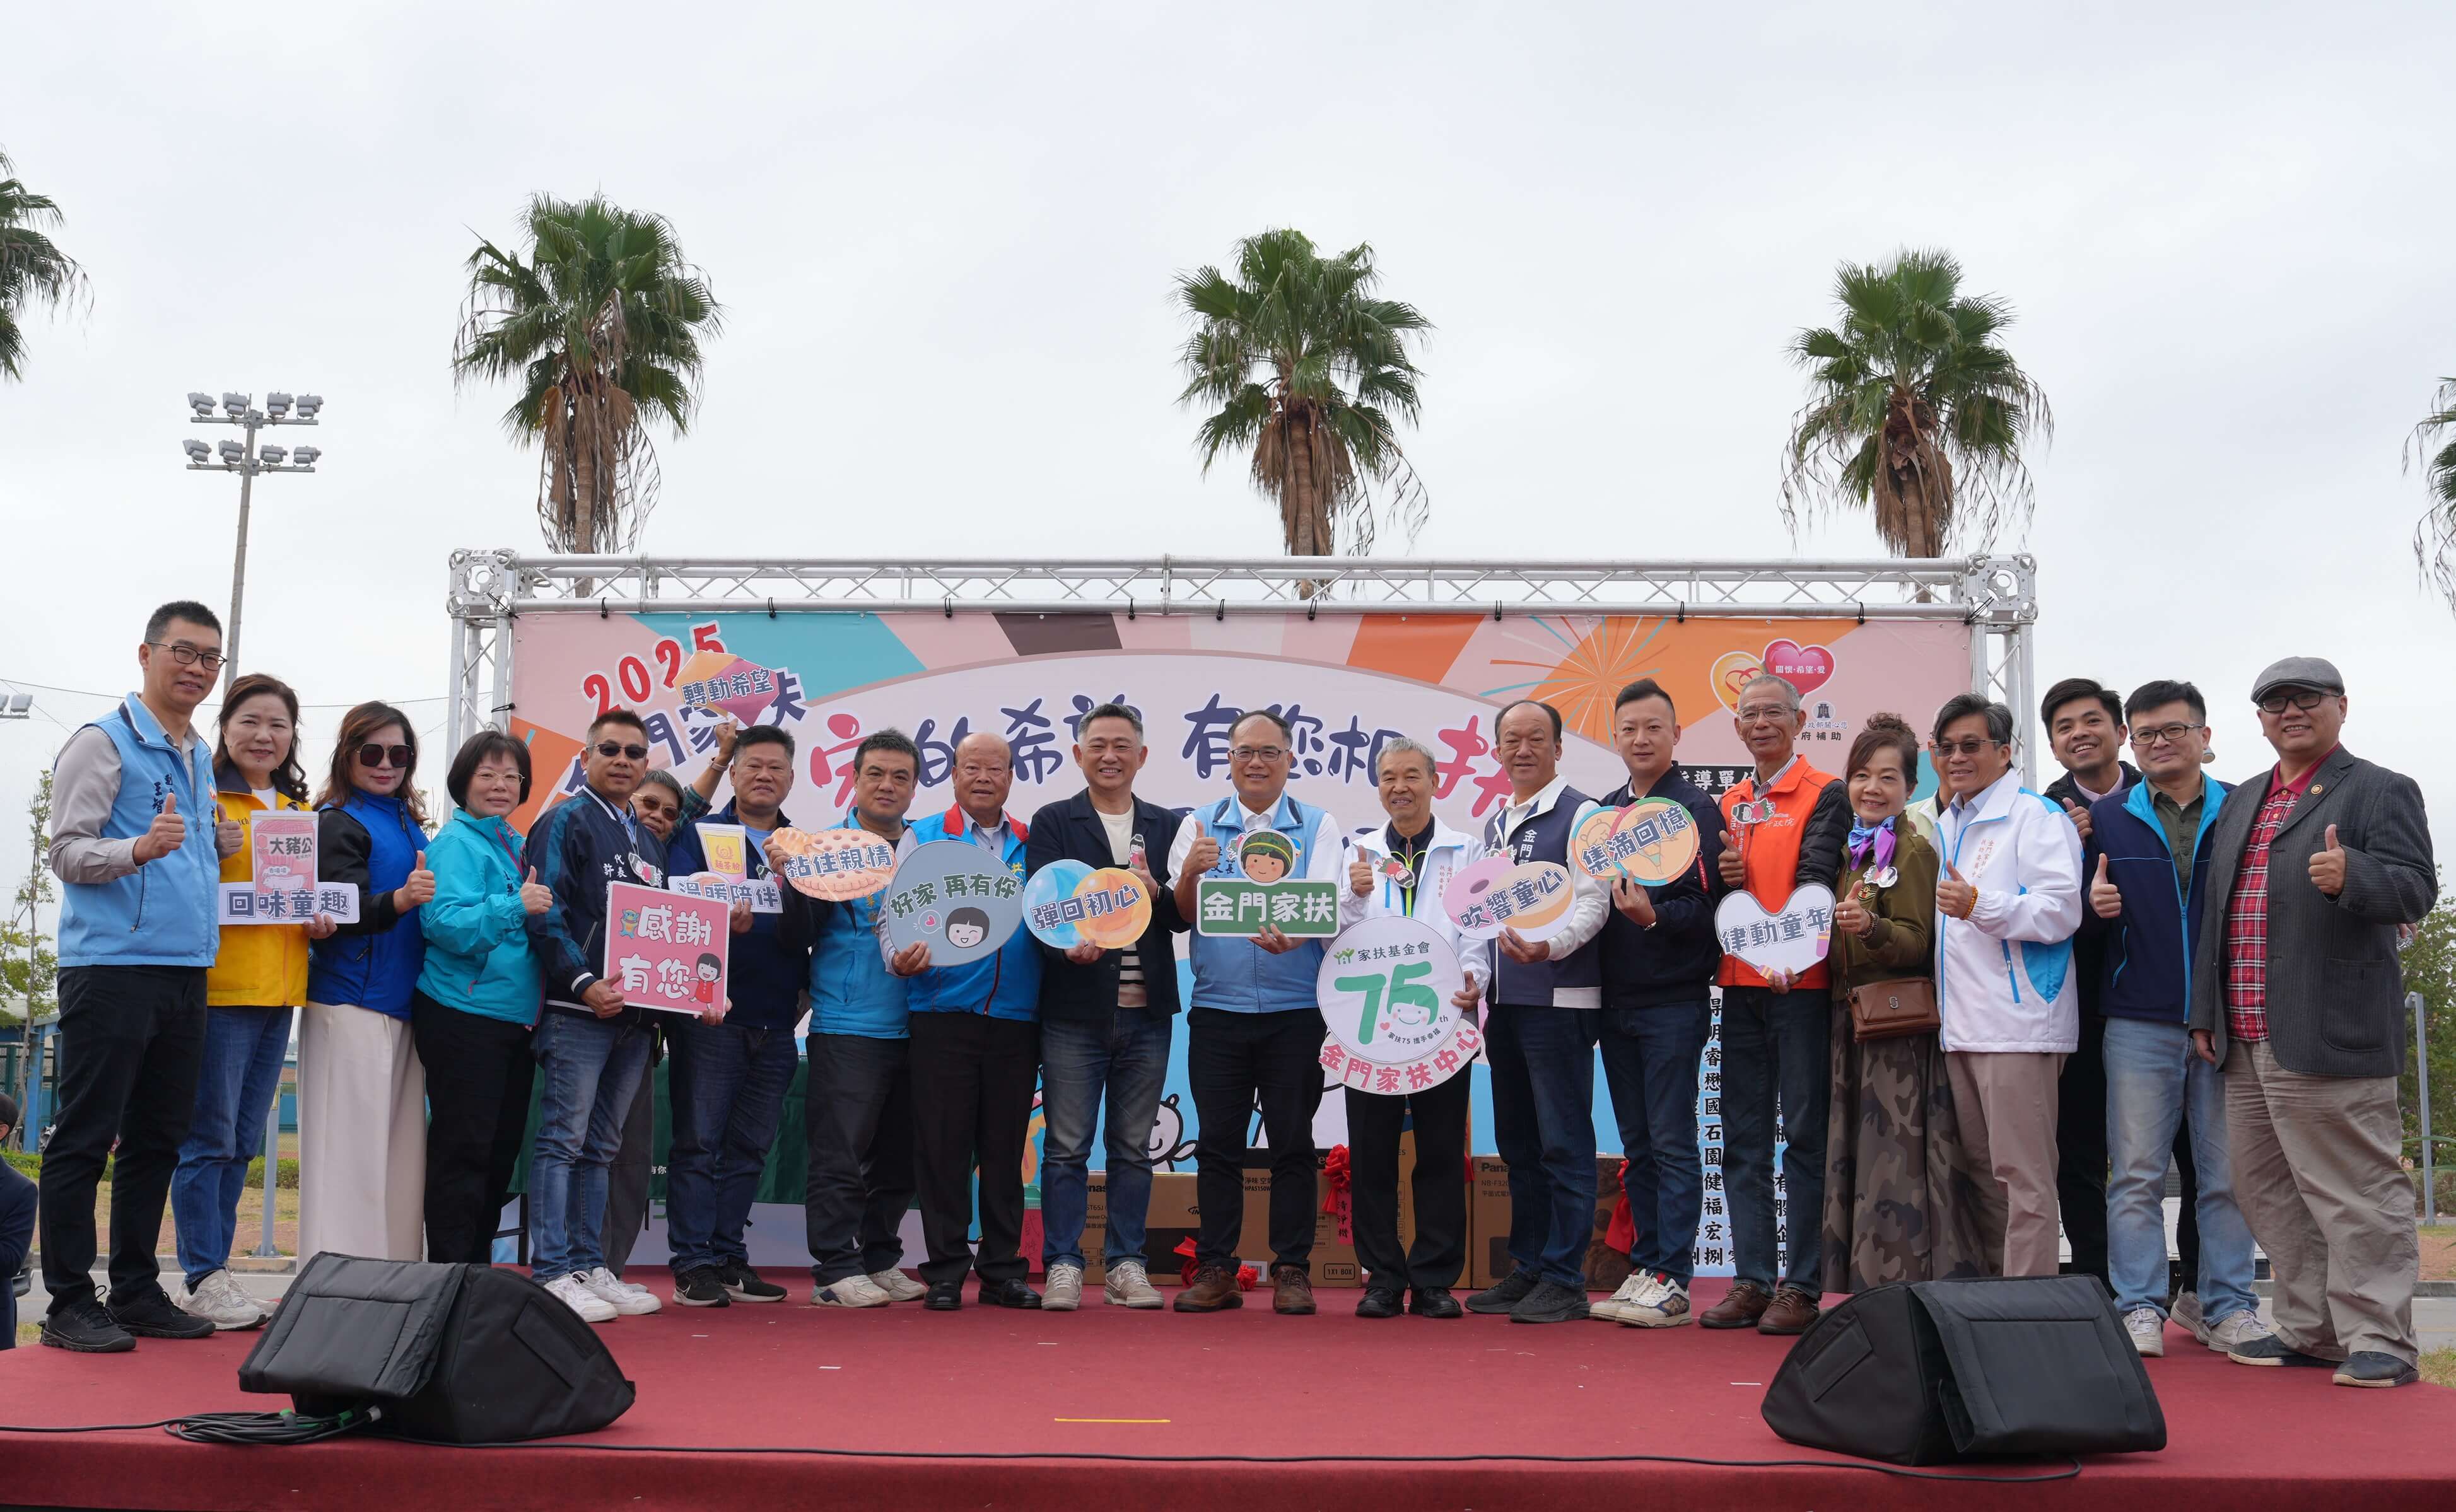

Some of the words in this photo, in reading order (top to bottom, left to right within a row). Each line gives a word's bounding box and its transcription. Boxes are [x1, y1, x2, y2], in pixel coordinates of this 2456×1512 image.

[682, 668, 774, 707] 轉動希望
[1794, 732, 1842, 741] 府補助
[1804, 721, 1847, 730] 政部關心您
[1680, 770, 1754, 791] 導單
[270, 837, 313, 855] 大豬公
[1582, 805, 1689, 876] 集滿回憶
[785, 844, 892, 878] 黏住親情
[228, 888, 349, 919] 回味童趣
[890, 882, 938, 919] 好家
[943, 873, 1020, 899] 再有你
[1031, 884, 1141, 932] 彈回初心
[1203, 891, 1335, 923] 金門家扶
[1459, 869, 1565, 929] 吹響童心
[638, 904, 712, 946] 感謝
[1721, 907, 1831, 955] 律動童年
[1357, 941, 1430, 962] 家扶基金會
[619, 953, 690, 998] 有您
[1319, 1027, 1482, 1092] 金門家扶中心
